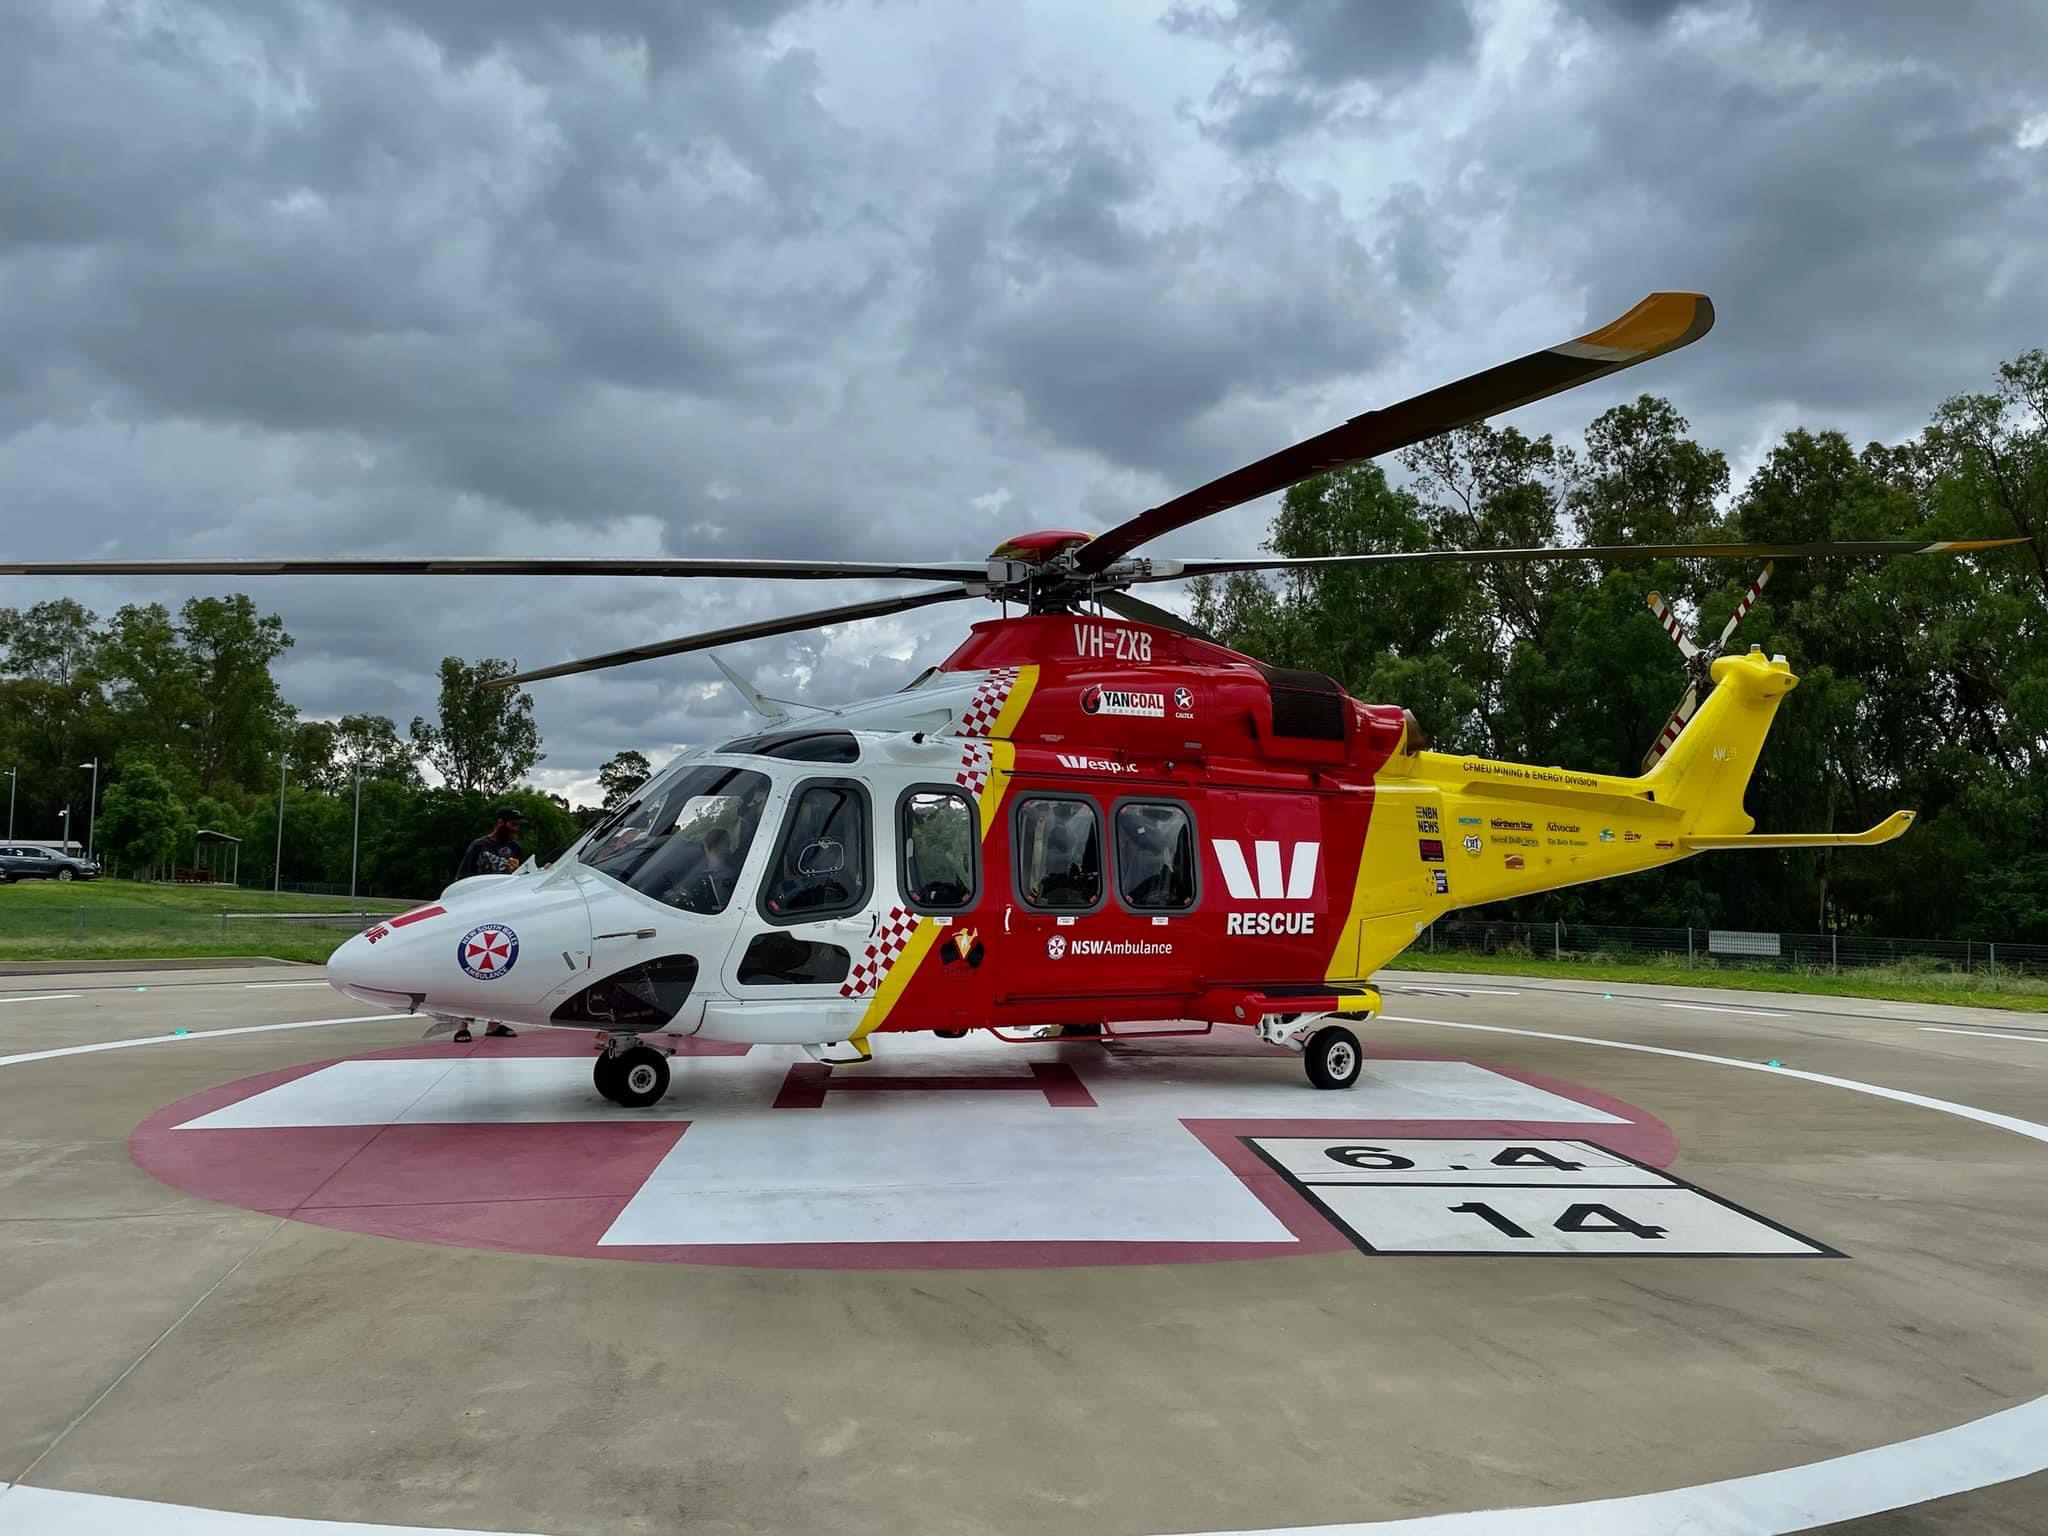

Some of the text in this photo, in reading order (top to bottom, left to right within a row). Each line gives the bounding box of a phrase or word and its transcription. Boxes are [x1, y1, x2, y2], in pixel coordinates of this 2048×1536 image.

[1074, 624, 1152, 661] VH-ZXB
[1104, 692, 1163, 709] YANCOAL
[1056, 754, 1139, 774] Westpc
[1463, 762, 1598, 788] CFMEU MINING & ENERGY DIVISION
[1422, 807, 1438, 820] NBN
[1418, 821, 1439, 834] NEWS
[1546, 821, 1581, 833] Advocate
[1227, 912, 1315, 936] RESCUE
[477, 924, 502, 932] SOUTH
[502, 927, 518, 947] WALES
[464, 966, 508, 979] AMBULANCE
[1323, 1146, 1587, 1172] 6.4
[1447, 1202, 1668, 1240] 14
